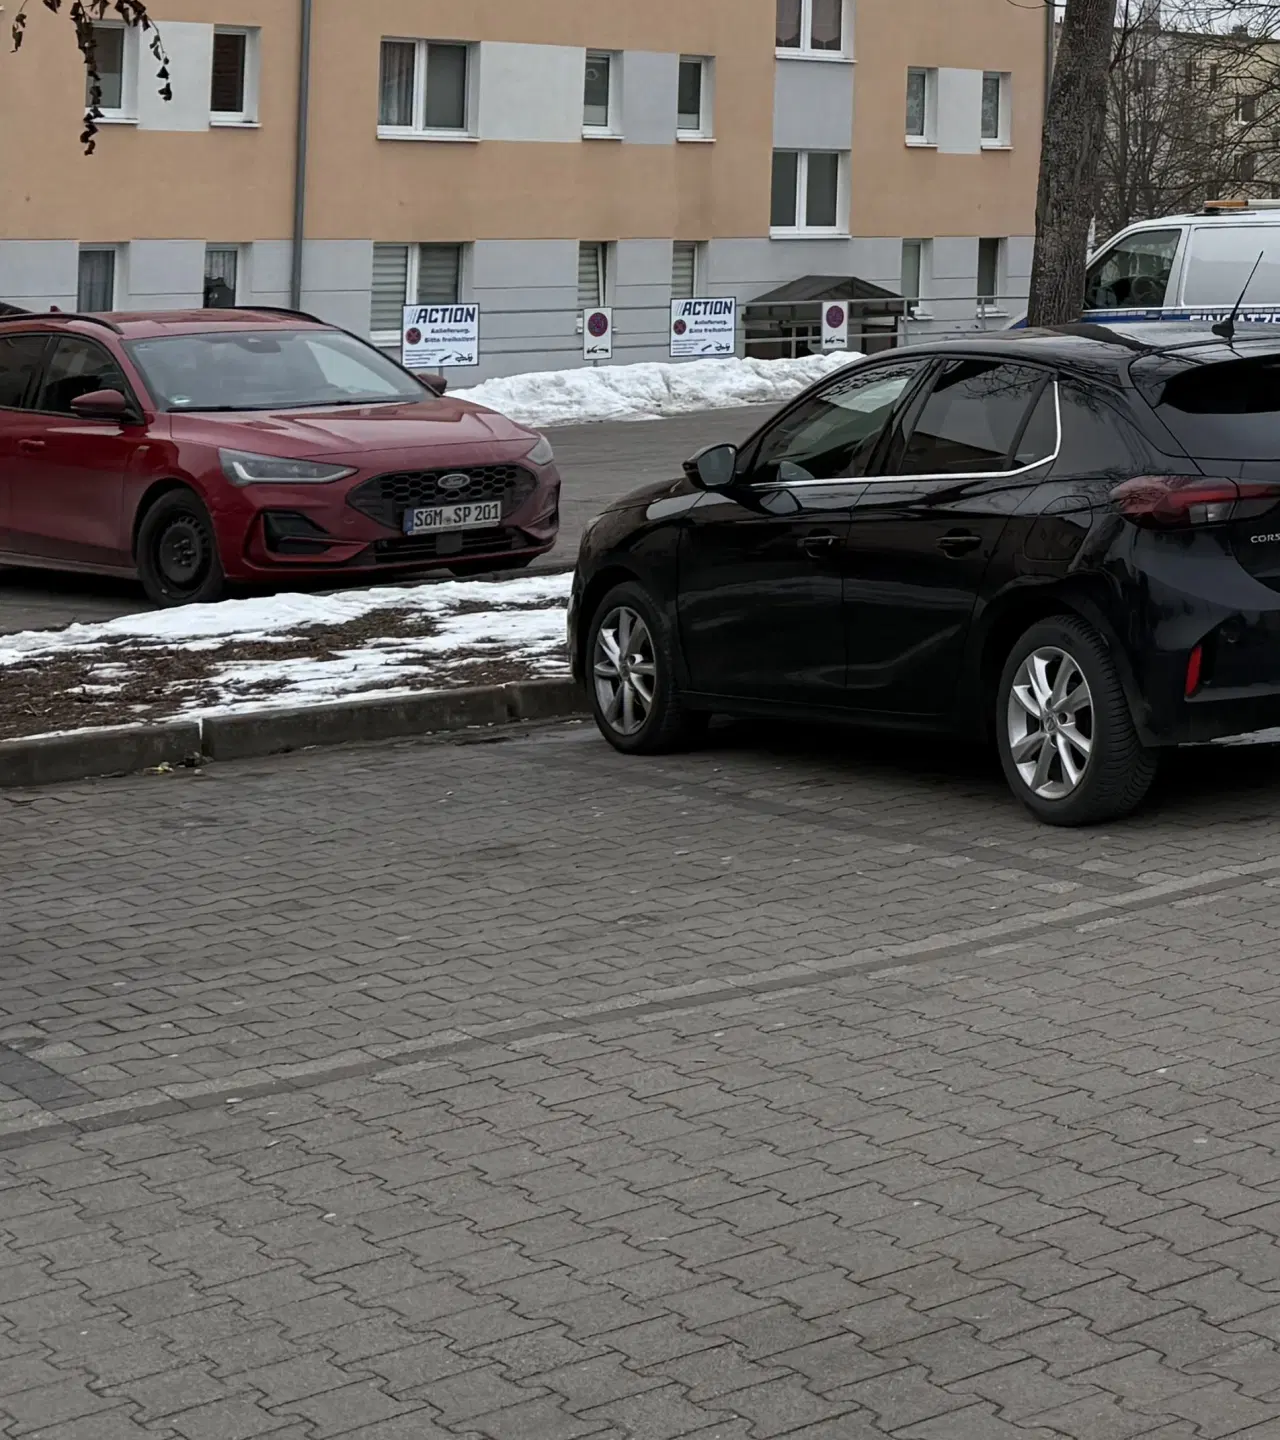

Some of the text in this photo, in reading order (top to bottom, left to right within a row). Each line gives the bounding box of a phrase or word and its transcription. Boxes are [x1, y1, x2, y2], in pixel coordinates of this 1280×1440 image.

[416, 307, 476, 324] ACTION
[682, 300, 733, 316] ACTION
[453, 506, 471, 524] SP
[474, 503, 499, 521] 201
